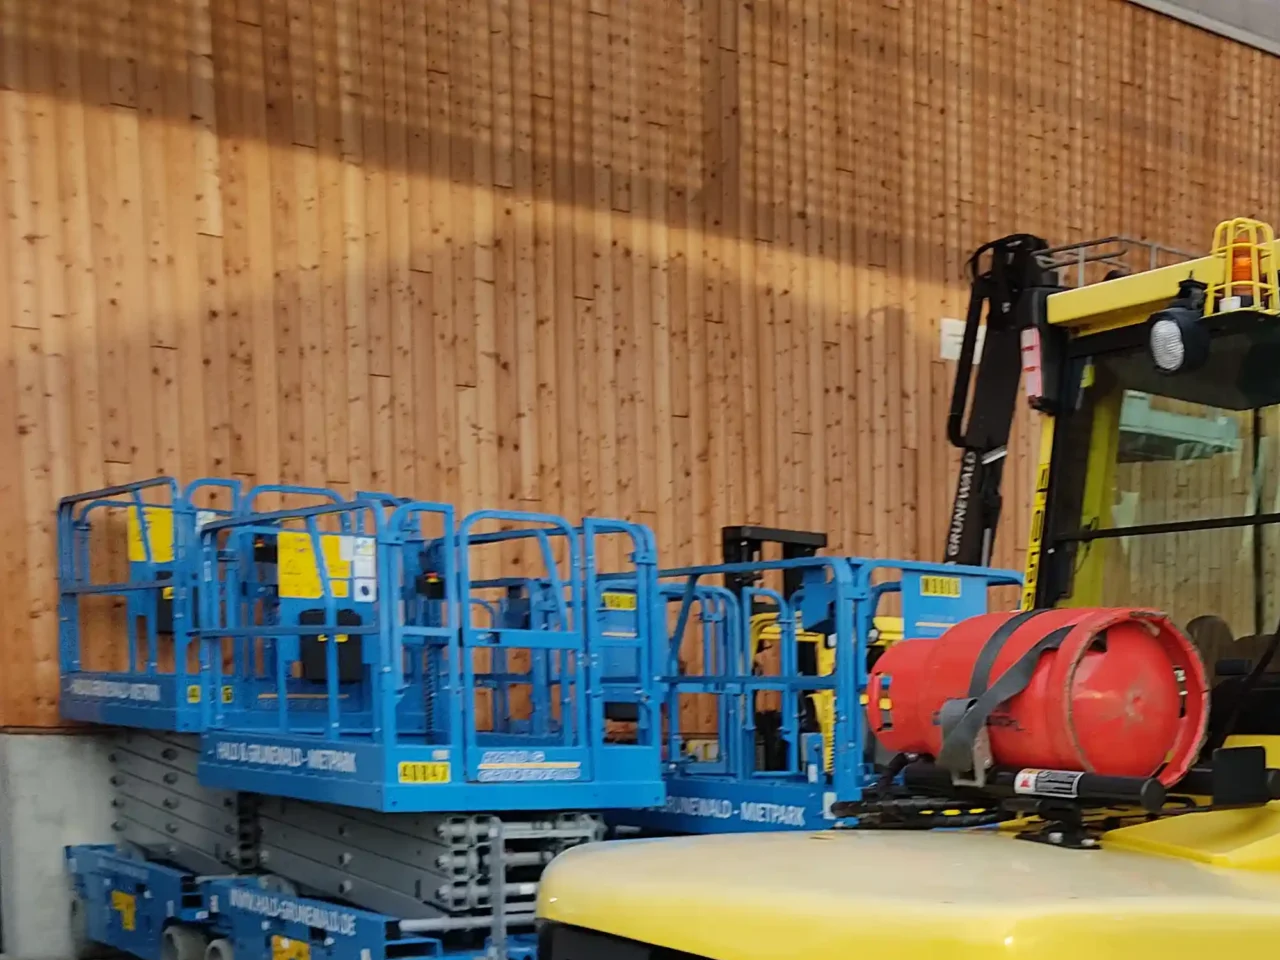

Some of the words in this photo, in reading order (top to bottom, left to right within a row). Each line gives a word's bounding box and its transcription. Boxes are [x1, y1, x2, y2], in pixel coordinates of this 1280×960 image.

[948, 451, 977, 556] GRUNEWALD
[661, 796, 732, 818] RUNEWALD
[740, 801, 806, 827] MIETPARK
